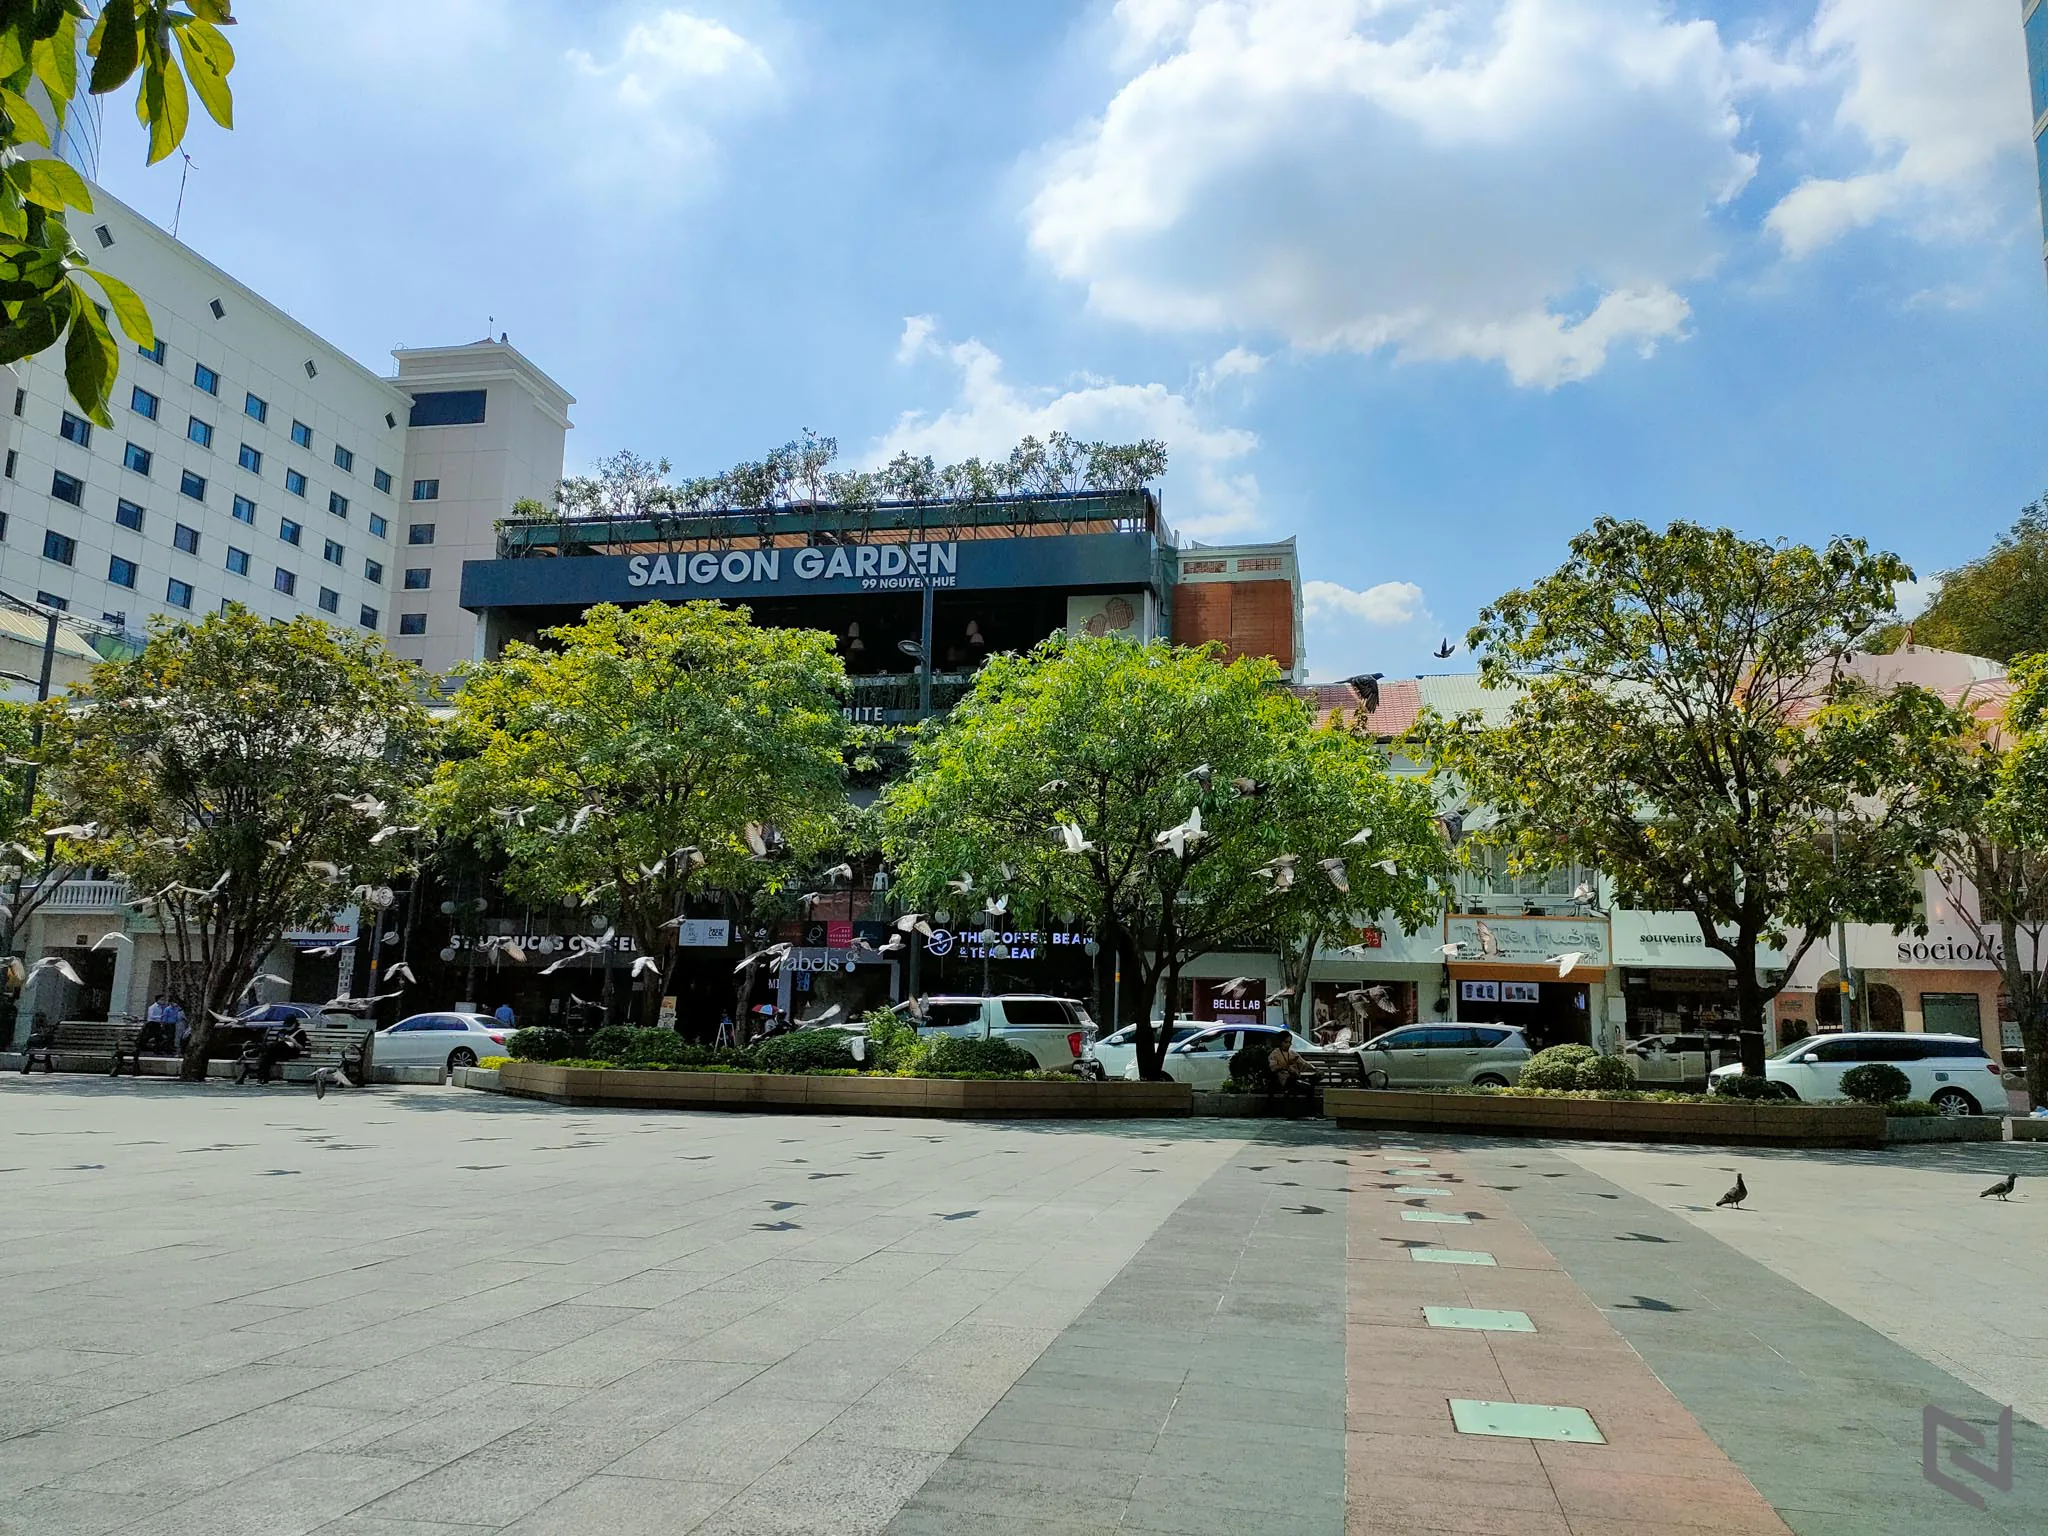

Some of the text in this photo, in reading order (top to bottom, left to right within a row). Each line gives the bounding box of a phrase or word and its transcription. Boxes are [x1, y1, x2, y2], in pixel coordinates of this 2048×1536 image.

[628, 542, 957, 587] SAIGON GARDEN
[862, 579, 877, 589] 99
[932, 576, 956, 587] HUE
[1640, 933, 1702, 944] souvenirs
[1213, 999, 1261, 1010] BELLE LAB
